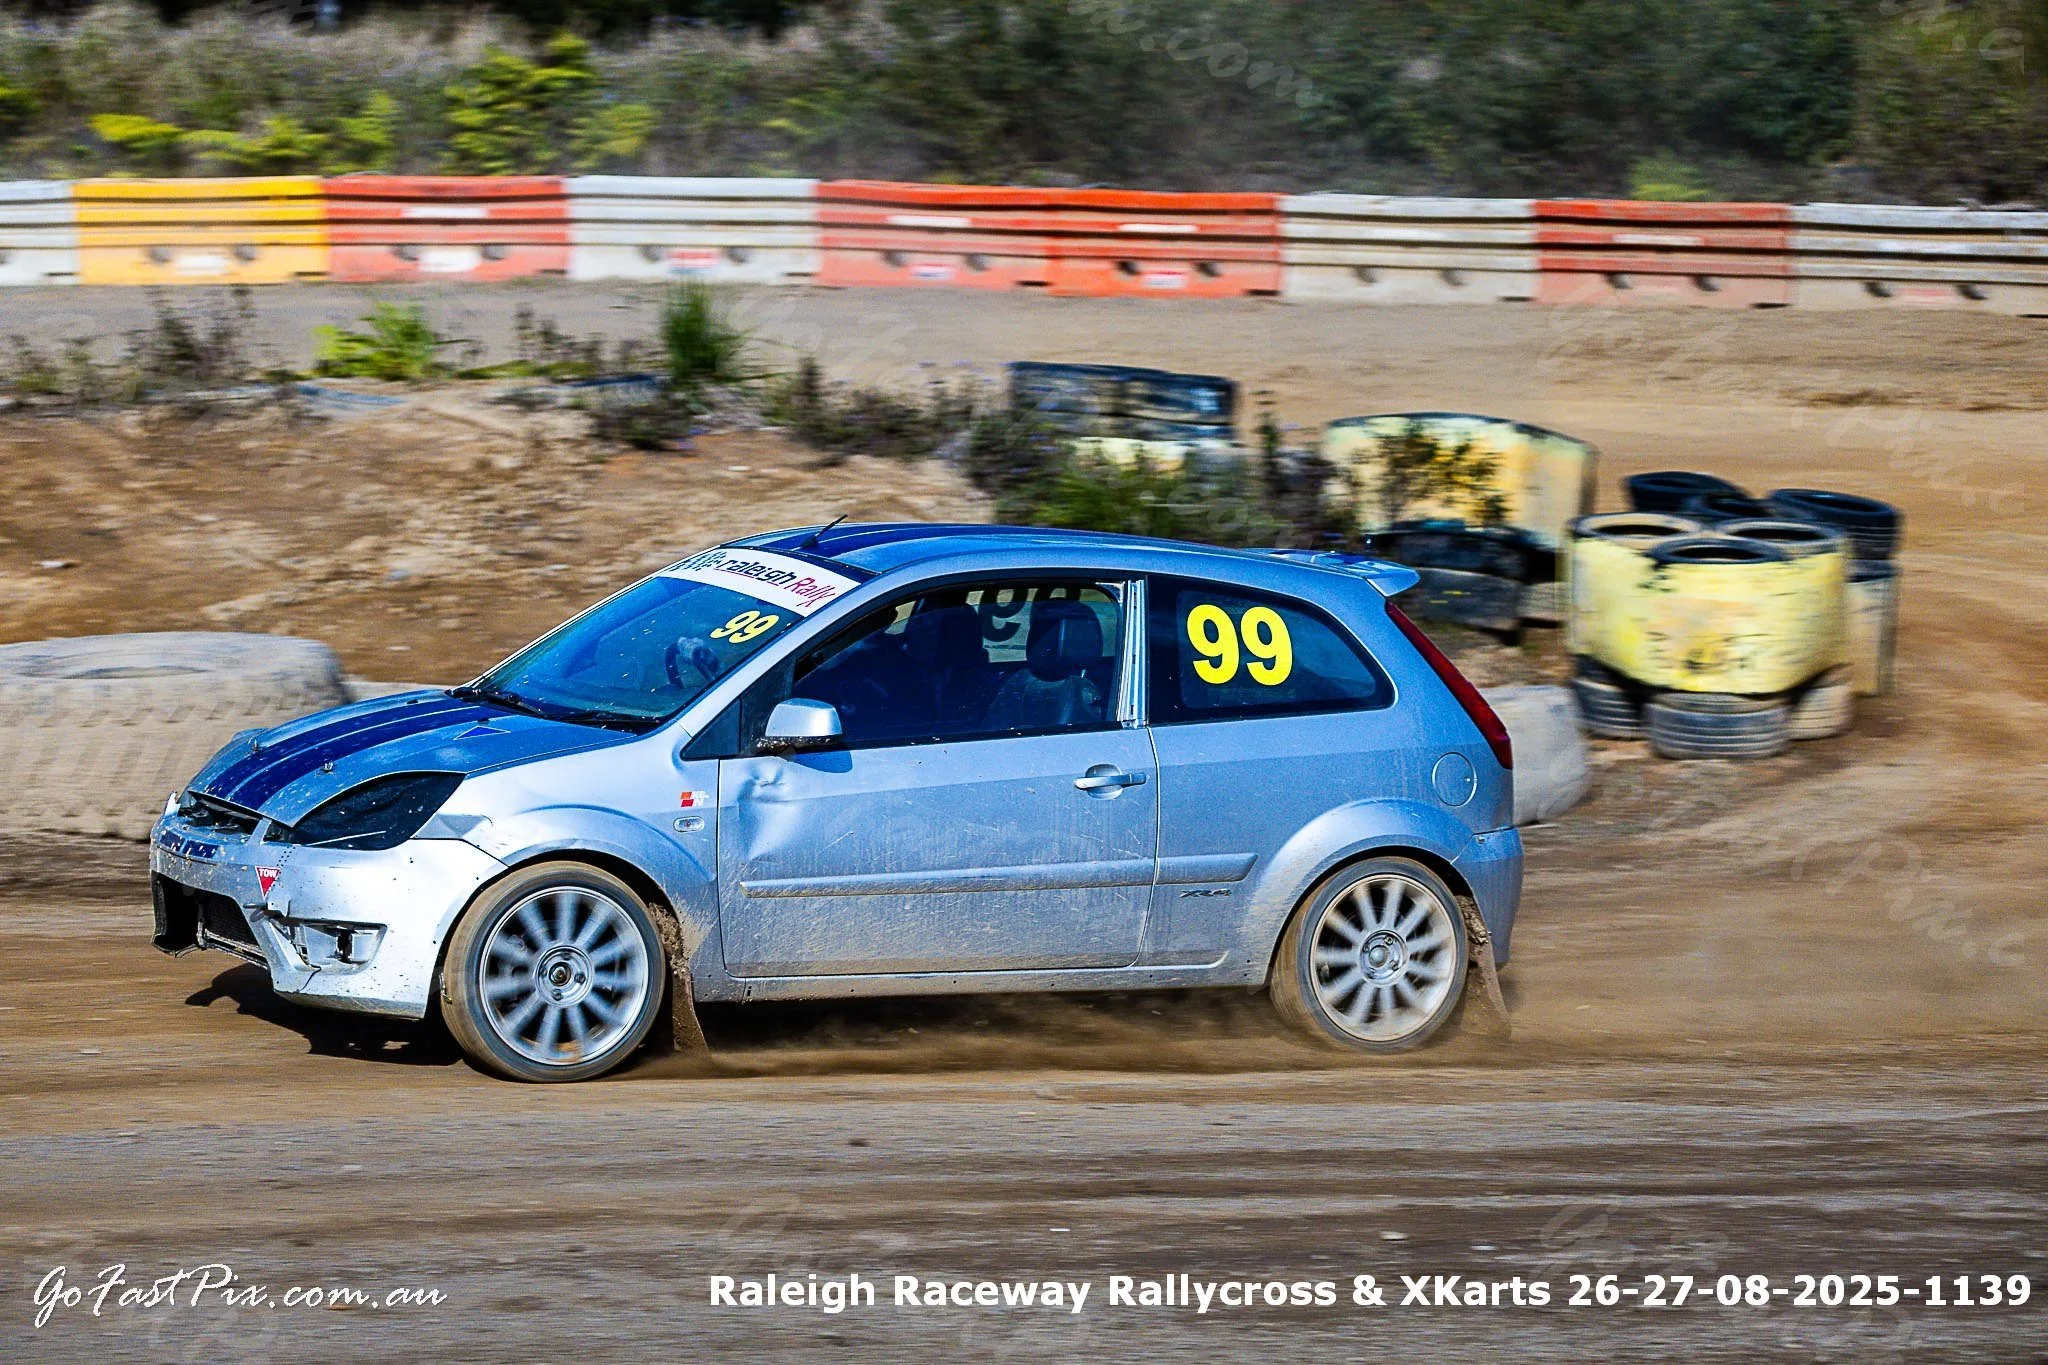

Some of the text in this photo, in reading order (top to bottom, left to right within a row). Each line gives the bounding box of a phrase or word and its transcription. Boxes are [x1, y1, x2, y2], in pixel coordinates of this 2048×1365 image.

[717, 558, 835, 607] raleigh Rally
[710, 610, 779, 643] 99
[1187, 604, 1292, 686] 99
[259, 868, 277, 878] TOW
